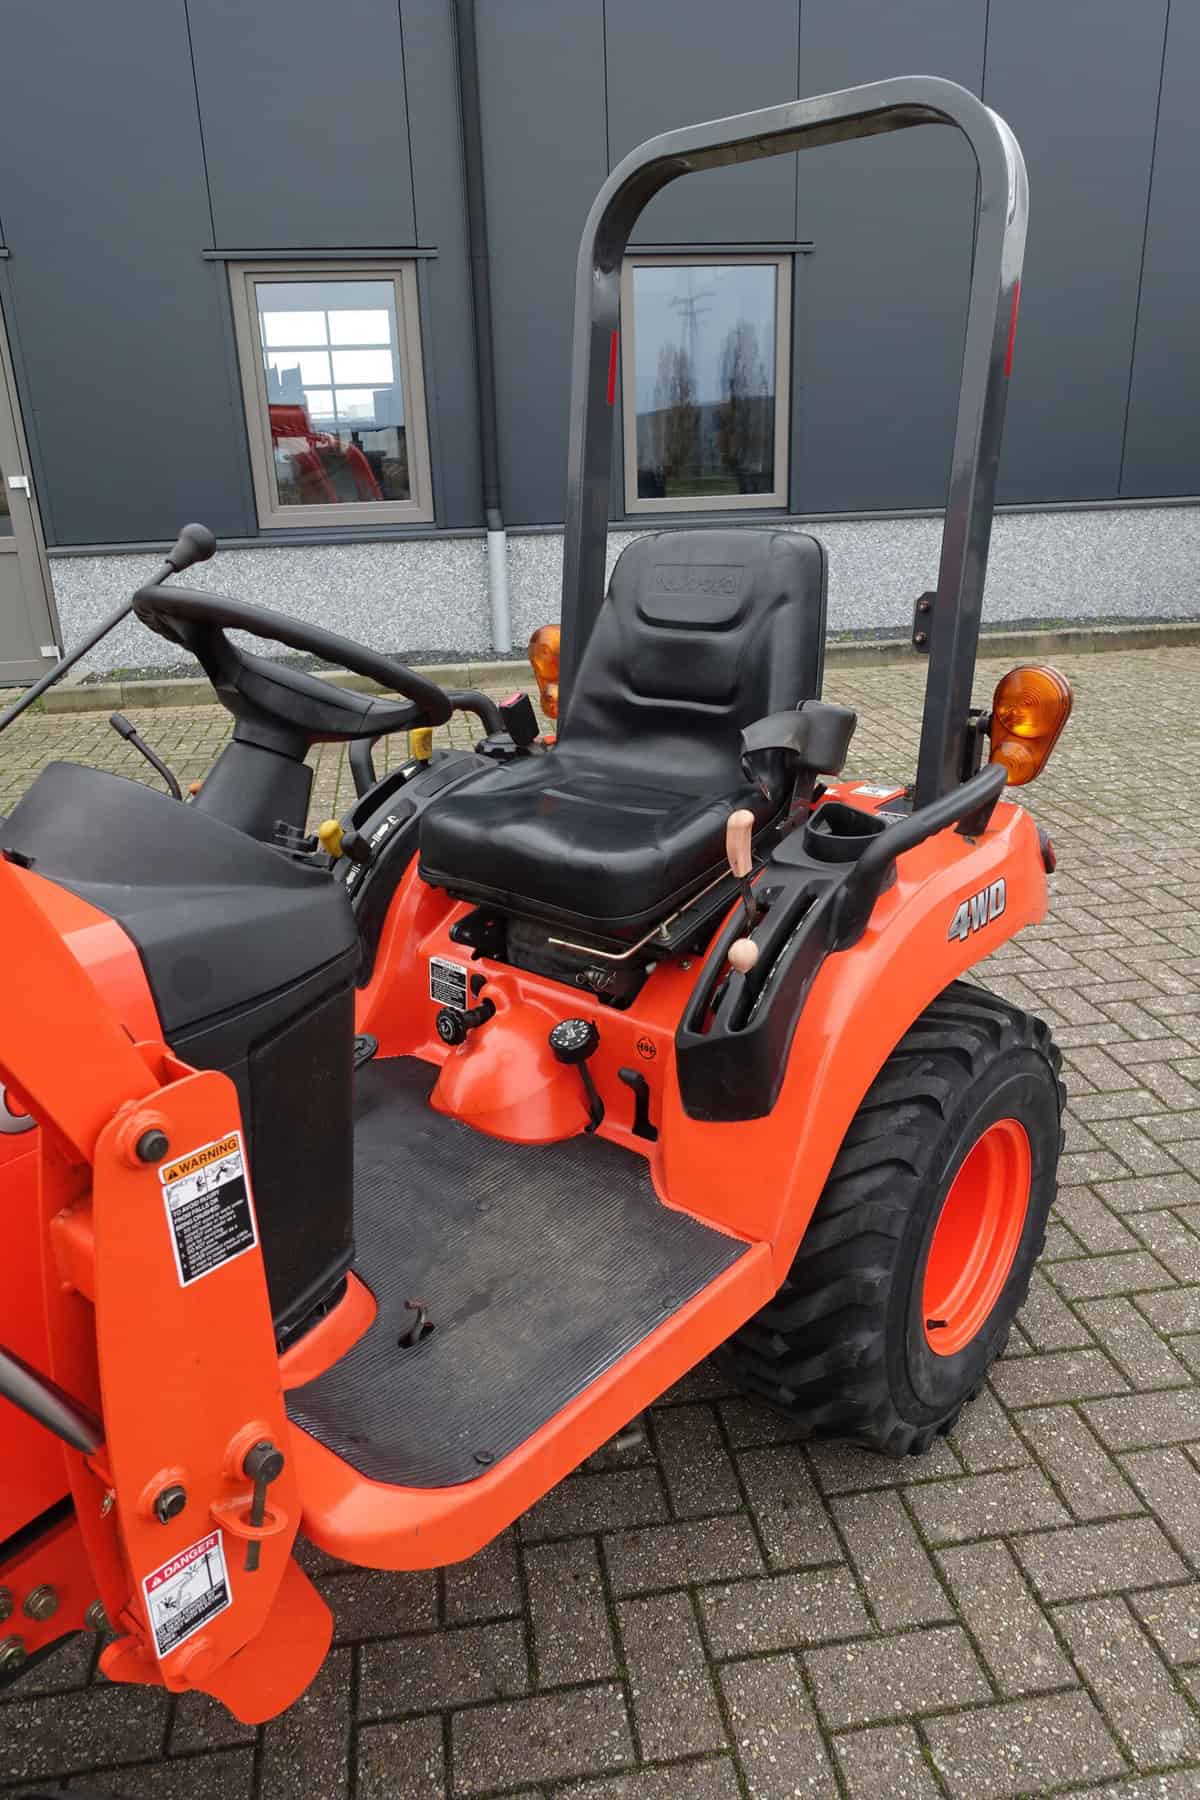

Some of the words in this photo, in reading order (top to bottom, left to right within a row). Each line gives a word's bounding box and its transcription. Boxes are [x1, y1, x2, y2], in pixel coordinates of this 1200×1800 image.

[948, 877, 1006, 941] 4WD
[178, 1138, 237, 1173] WARNING
[163, 1538, 215, 1578] DANGER
